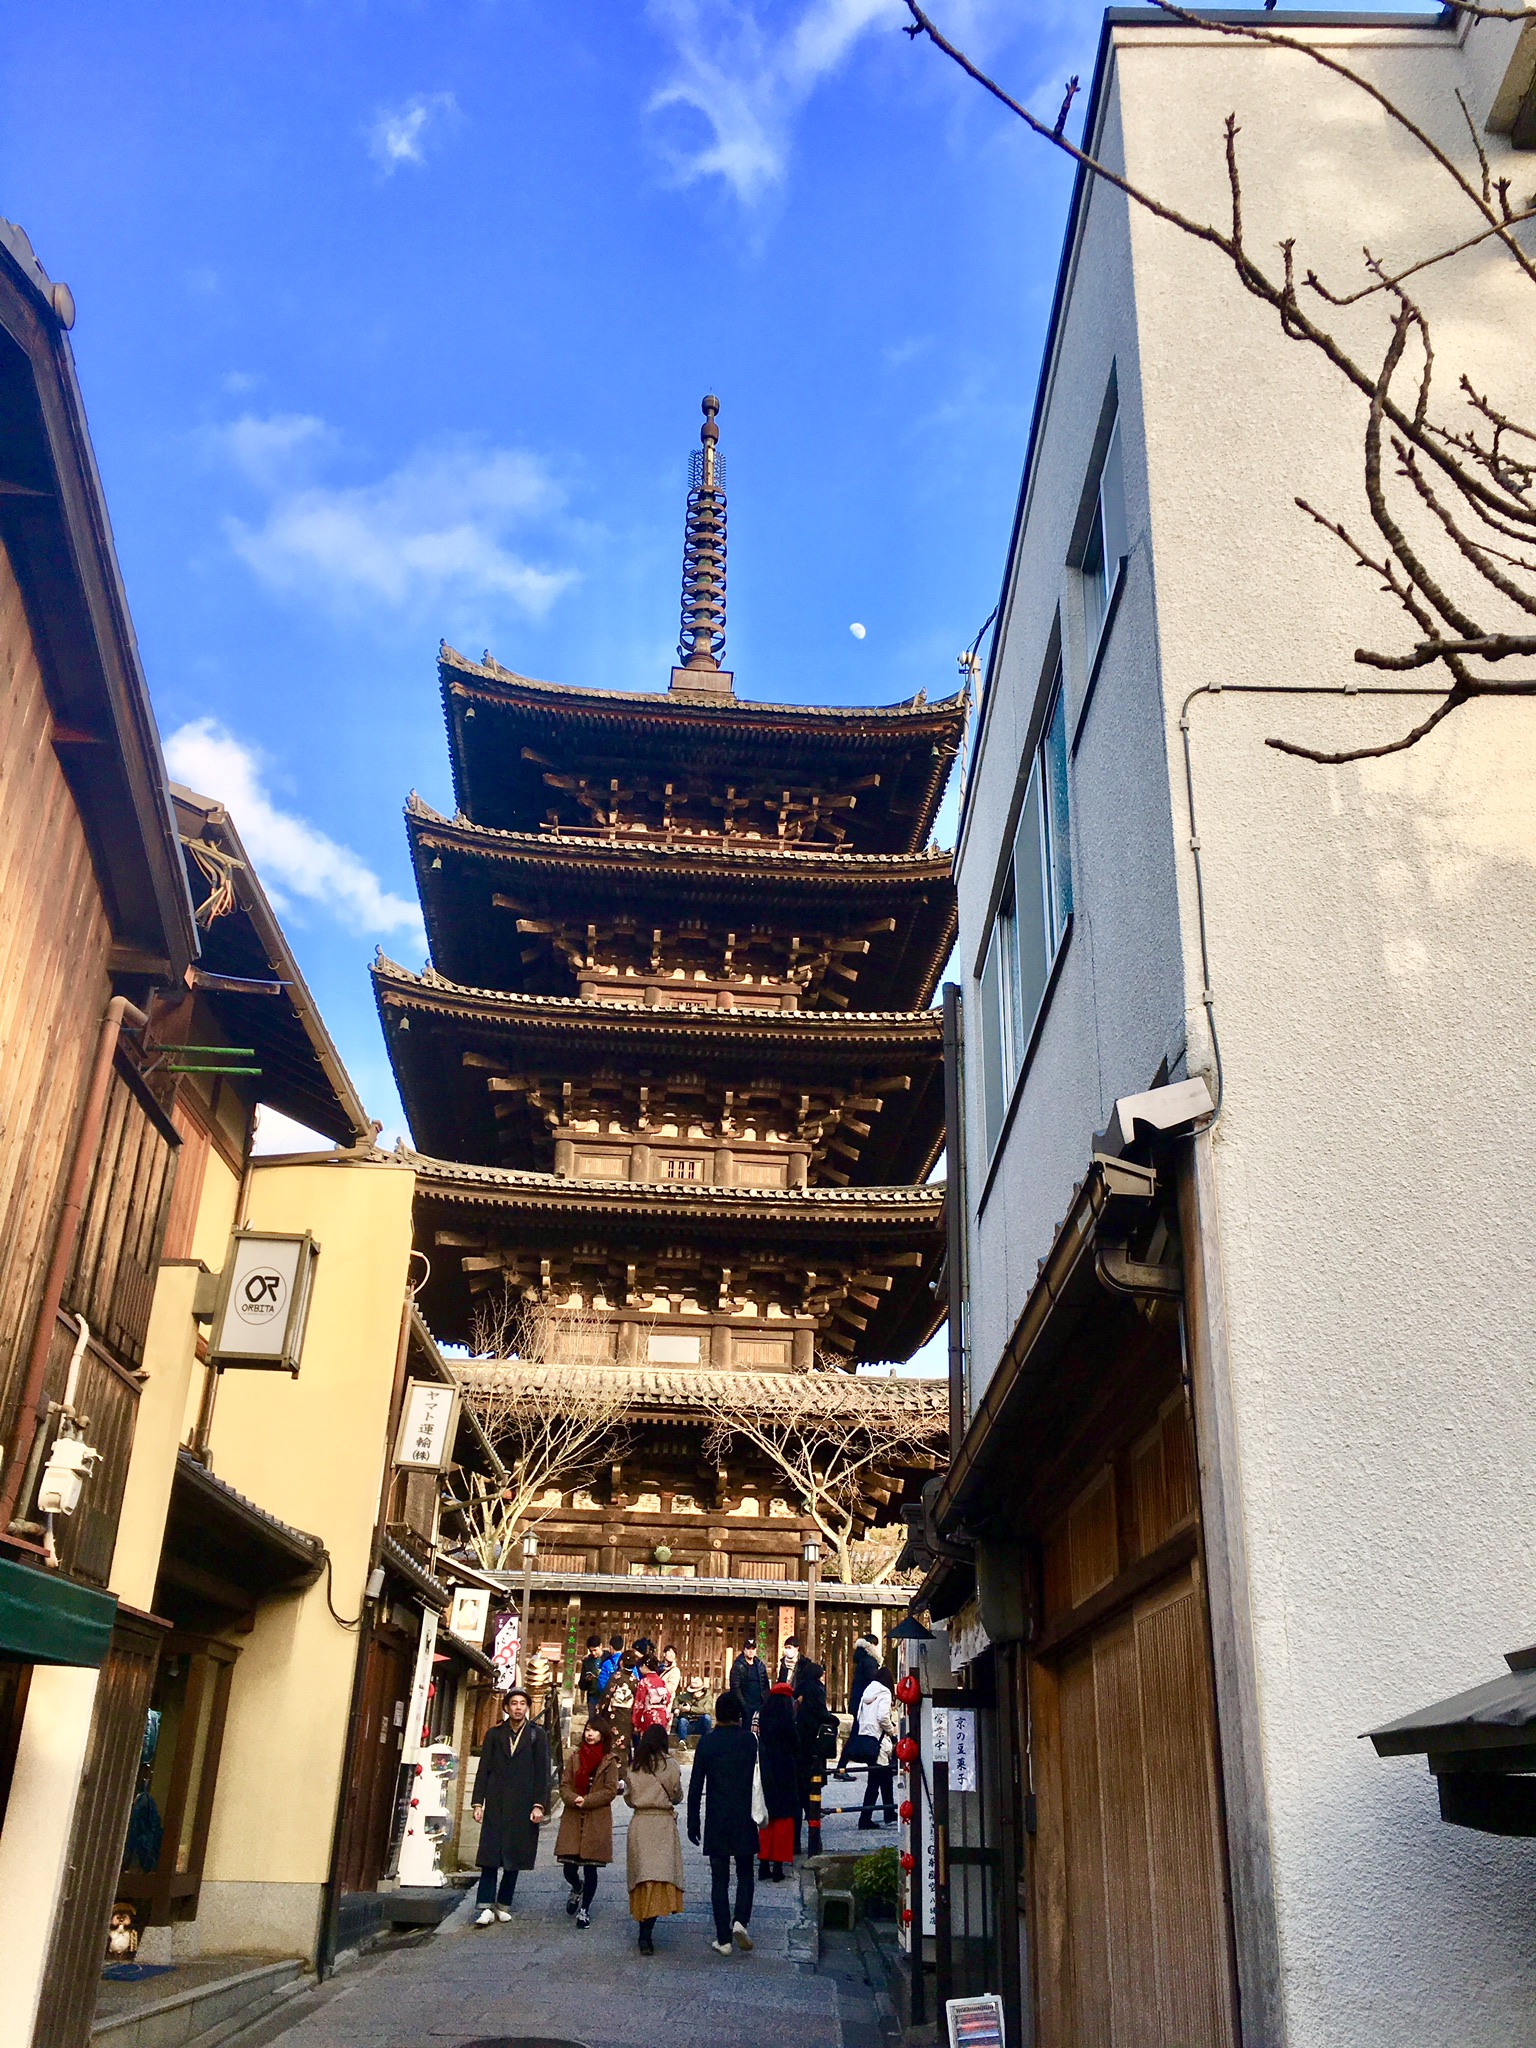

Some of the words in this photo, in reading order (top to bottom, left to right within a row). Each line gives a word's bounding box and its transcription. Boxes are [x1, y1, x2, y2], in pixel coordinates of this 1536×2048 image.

[245, 1275, 280, 1302] OR
[241, 1303, 275, 1313] ORBITA
[955, 1716, 968, 1786] 京の豆菓子
